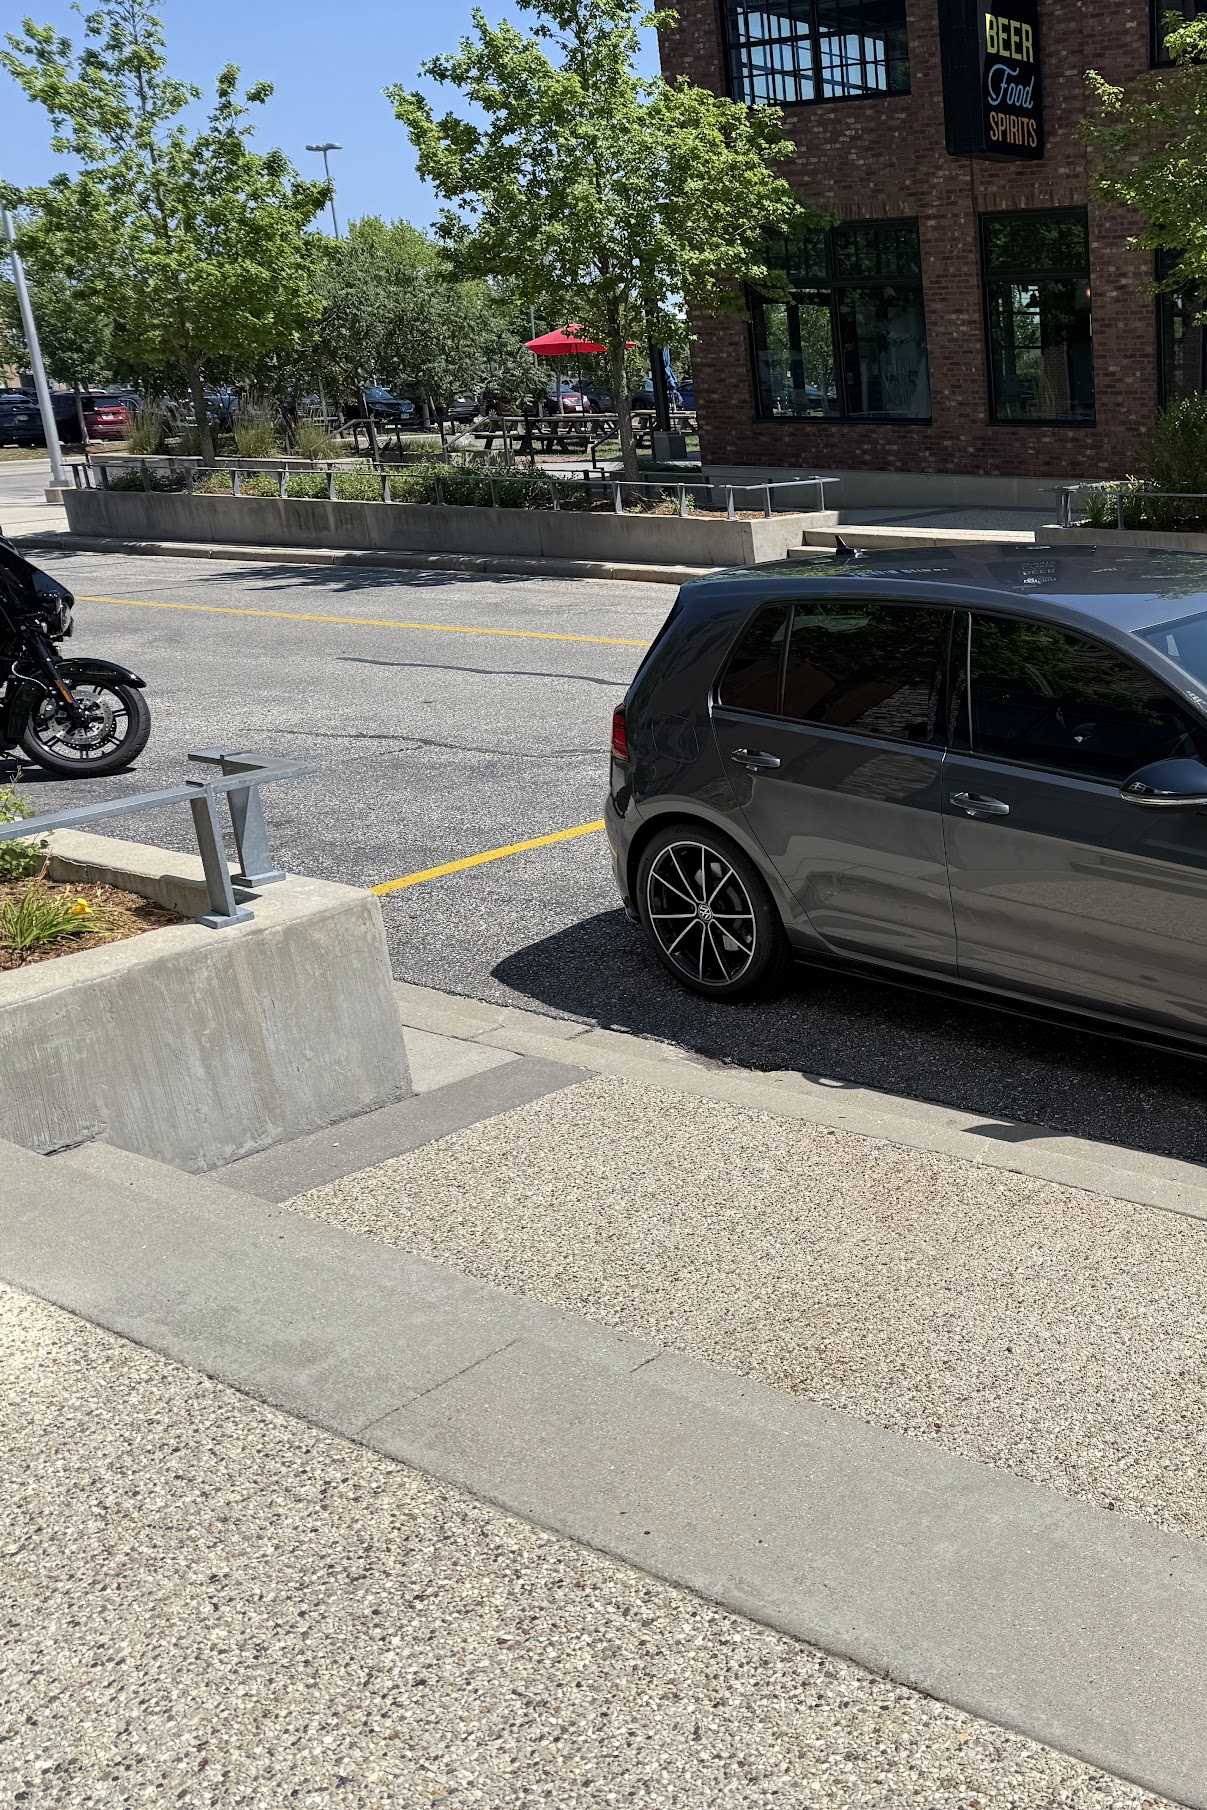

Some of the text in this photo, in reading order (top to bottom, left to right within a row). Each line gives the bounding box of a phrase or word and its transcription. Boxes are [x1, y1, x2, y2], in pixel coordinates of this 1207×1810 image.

[984, 13, 1034, 63] BEER
[988, 63, 1034, 109] Food
[989, 111, 1038, 148] SPIRITS
